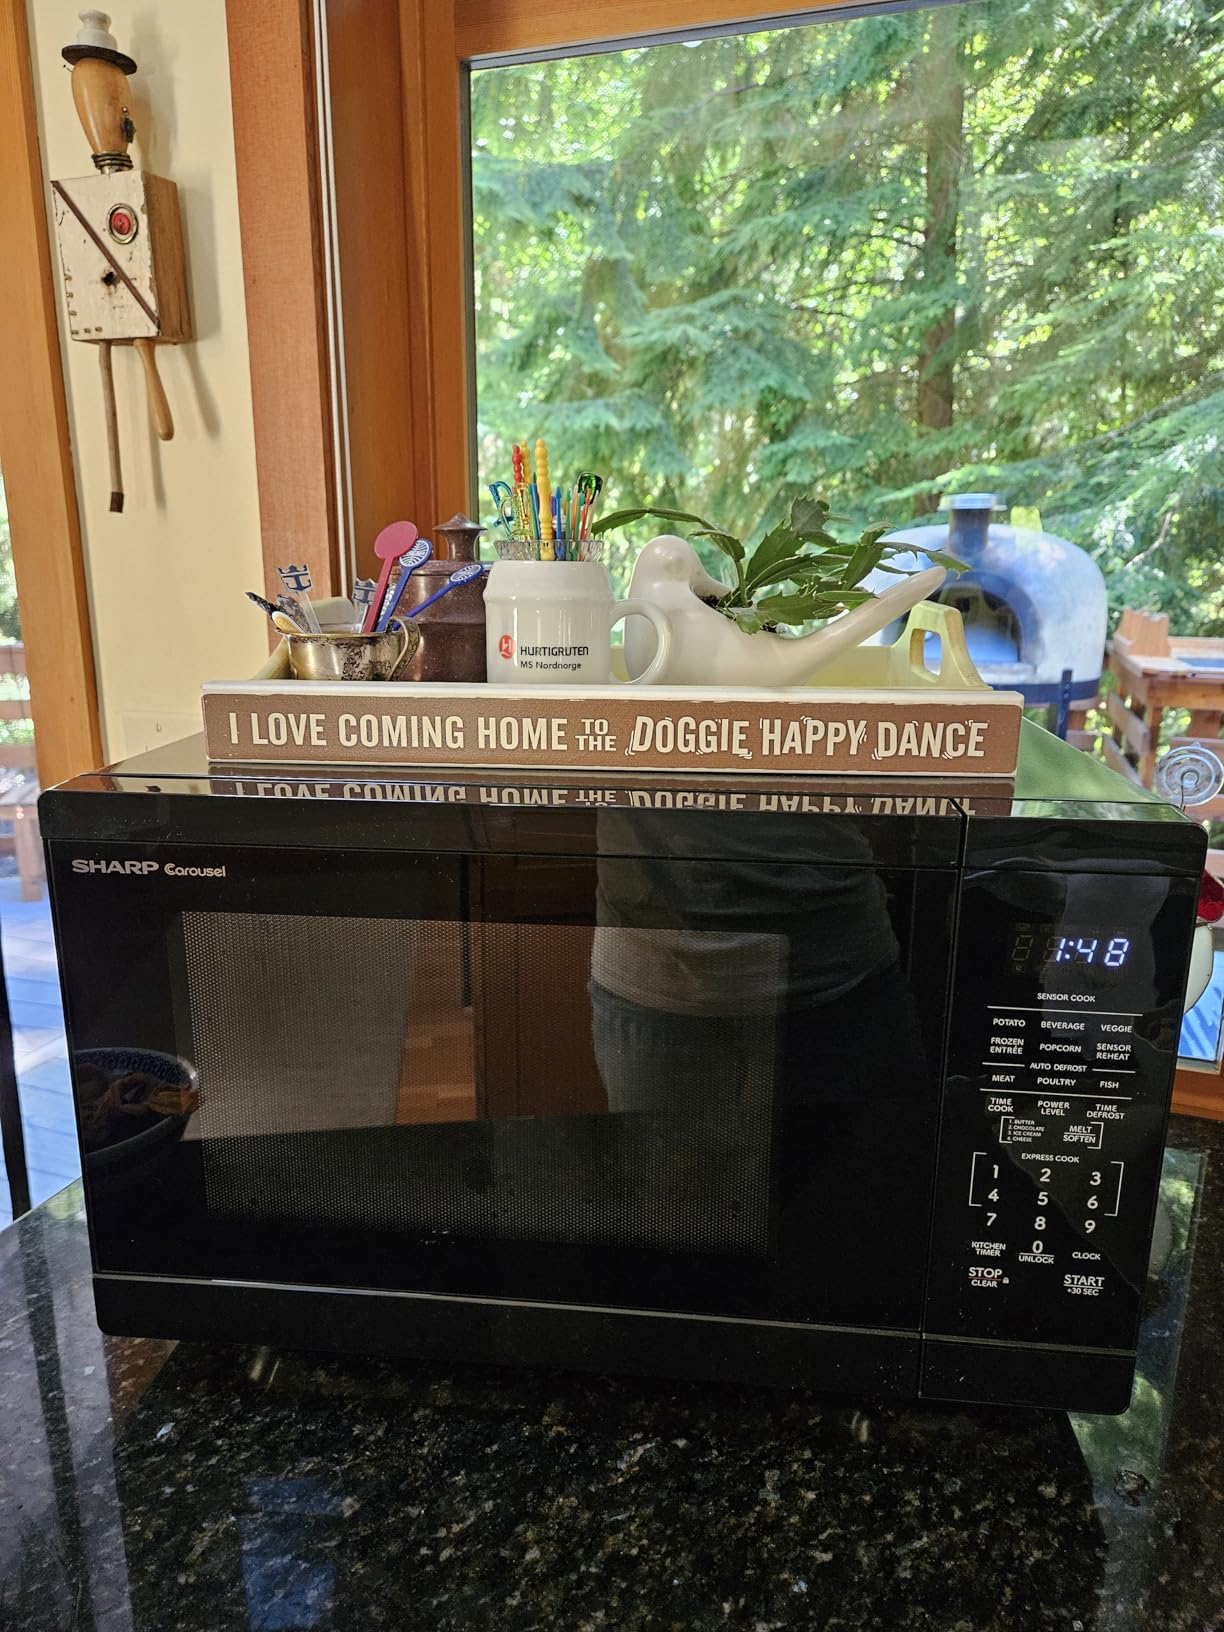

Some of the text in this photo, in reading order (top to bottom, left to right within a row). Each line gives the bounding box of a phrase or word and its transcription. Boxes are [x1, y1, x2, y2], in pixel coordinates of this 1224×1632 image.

[520, 647, 589, 656] HURTIGRUTEN
[520, 661, 581, 671] MS Nordnorge
[229, 712, 568, 750] I LOVE COMING HOME
[581, 719, 608, 735] TO
[632, 715, 988, 758] DOGGIE HAPPY DANCE
[575, 735, 617, 751] THE
[71, 859, 226, 877] SHARP Carousel
[1055, 938, 1129, 967] 1:48
[1037, 992, 1096, 1002] SENSOR COOK
[993, 1018, 1026, 1028] POTATO
[1040, 1021, 1085, 1031] BEVERAGE
[1100, 1024, 1132, 1033] VEGGIE
[990, 1037, 1024, 1046] FROZEN
[990, 1045, 1023, 1055] ENTRÉE
[1039, 1043, 1082, 1053] POPCORN
[1096, 1043, 1132, 1052] SENSOR
[1096, 1052, 1130, 1061] REHEAT
[1029, 1062, 1087, 1073] AUTO DEFROST
[1037, 1077, 1076, 1086] POULTRY
[1099, 1080, 1119, 1089] FISH
[990, 1097, 1012, 1106] TIME
[1037, 1100, 1070, 1109] POWER
[987, 1105, 1014, 1113] COOK
[1041, 1107, 1065, 1116] LEVEL
[1095, 1103, 1118, 1112] TIME
[1086, 1110, 1125, 1120] DEFROST
[1069, 1125, 1092, 1133] MELT
[1063, 1135, 1096, 1144] SOFTEN
[1021, 1153, 1080, 1163] EXPRESS COOK
[992, 1165, 999, 1179] 1
[1039, 1168, 1052, 1182] 2
[1089, 1172, 1101, 1186] 3
[988, 1189, 1000, 1202] 4
[1037, 1192, 1049, 1206] 5
[1087, 1195, 1099, 1209] 6
[986, 1213, 997, 1226] 7
[1034, 1216, 1046, 1230] 8
[1085, 1220, 1096, 1234] 9
[971, 1241, 1006, 1250] KITCHEN
[1032, 1240, 1043, 1254] 0
[976, 1248, 1001, 1257] TIMER
[1072, 1252, 1101, 1260] CLOCK
[1018, 1255, 1054, 1264] UNLOCK
[968, 1267, 1003, 1279] STOP
[971, 1279, 998, 1288] CLEAR
[1064, 1274, 1105, 1286] START
[1083, 1288, 1099, 1296] SEC
